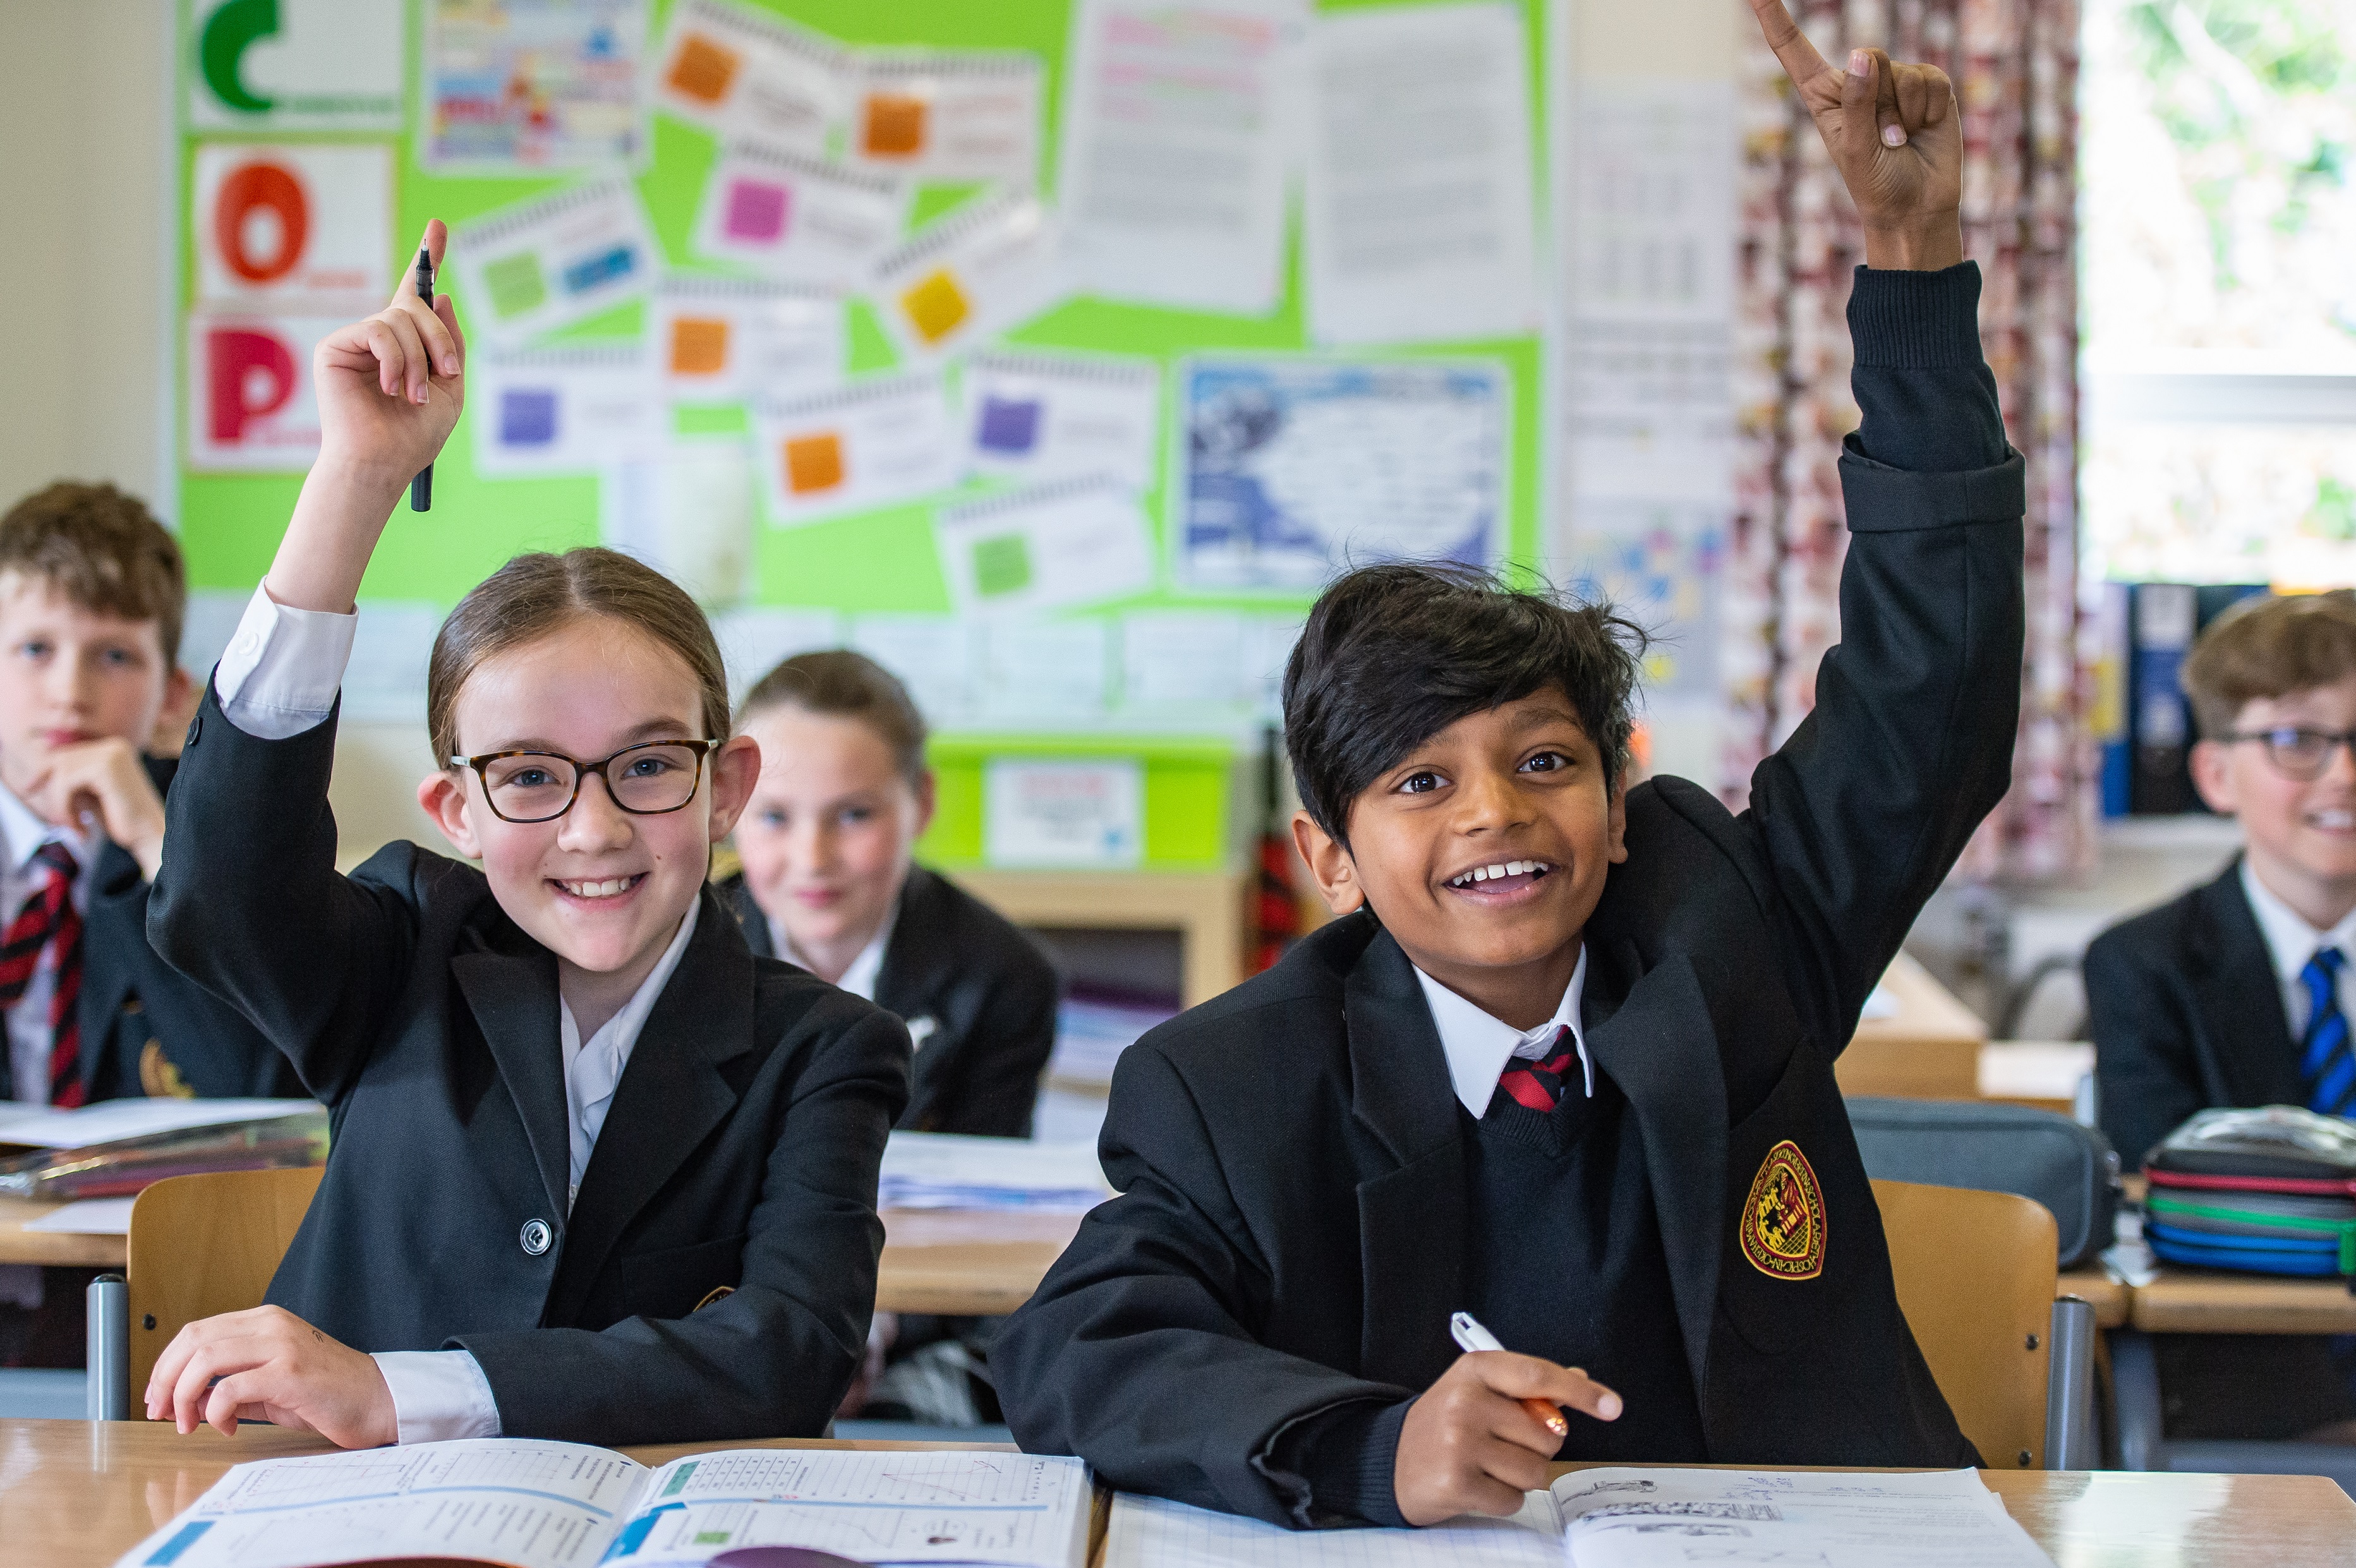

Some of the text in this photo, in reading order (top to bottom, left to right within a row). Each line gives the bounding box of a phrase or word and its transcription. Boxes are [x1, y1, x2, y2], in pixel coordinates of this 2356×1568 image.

[201, 0, 282, 112] C
[215, 163, 310, 284] O
[209, 329, 297, 446] P
